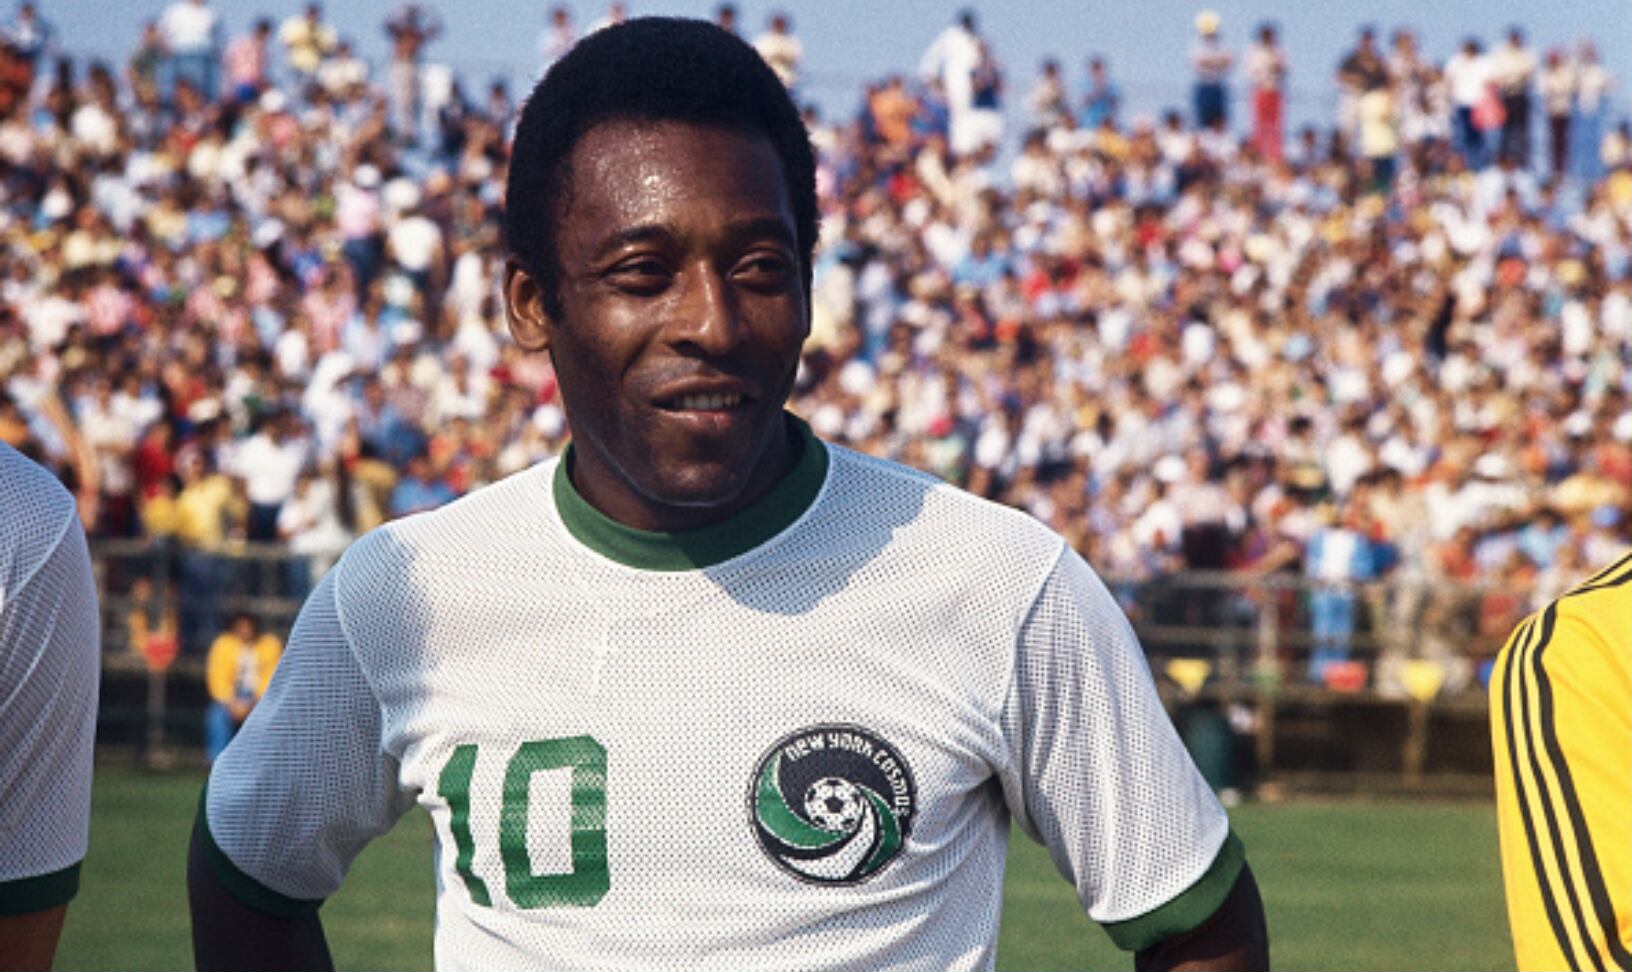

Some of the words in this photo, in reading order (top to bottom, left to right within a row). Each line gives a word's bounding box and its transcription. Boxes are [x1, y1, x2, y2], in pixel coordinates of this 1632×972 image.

[437, 735, 610, 909] 10
[785, 733, 825, 761] NEW
[828, 732, 873, 757] YORK
[873, 749, 910, 817] COSMOS
